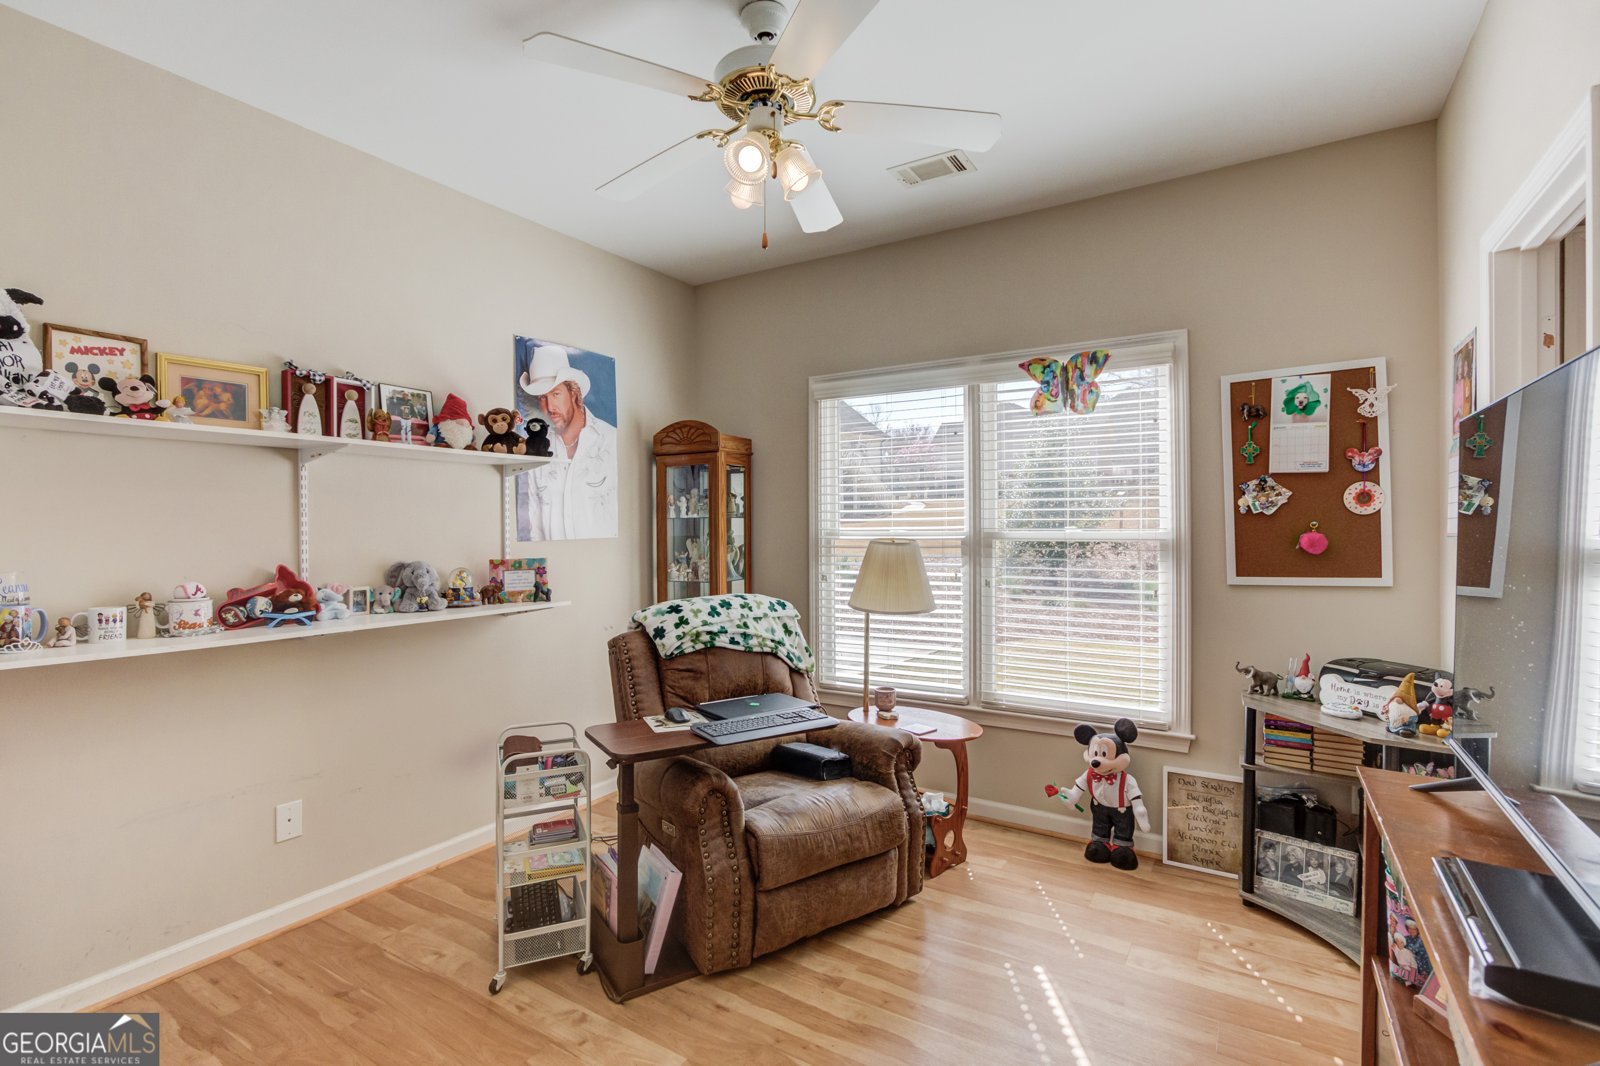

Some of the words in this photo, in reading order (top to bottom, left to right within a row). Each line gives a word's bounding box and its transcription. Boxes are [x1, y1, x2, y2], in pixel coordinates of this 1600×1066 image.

[69, 345, 126, 356] MICKEY
[98, 633, 123, 641] FRIEND
[1330, 682, 1350, 694] Home
[1364, 692, 1387, 702] where
[1337, 695, 1348, 703] my
